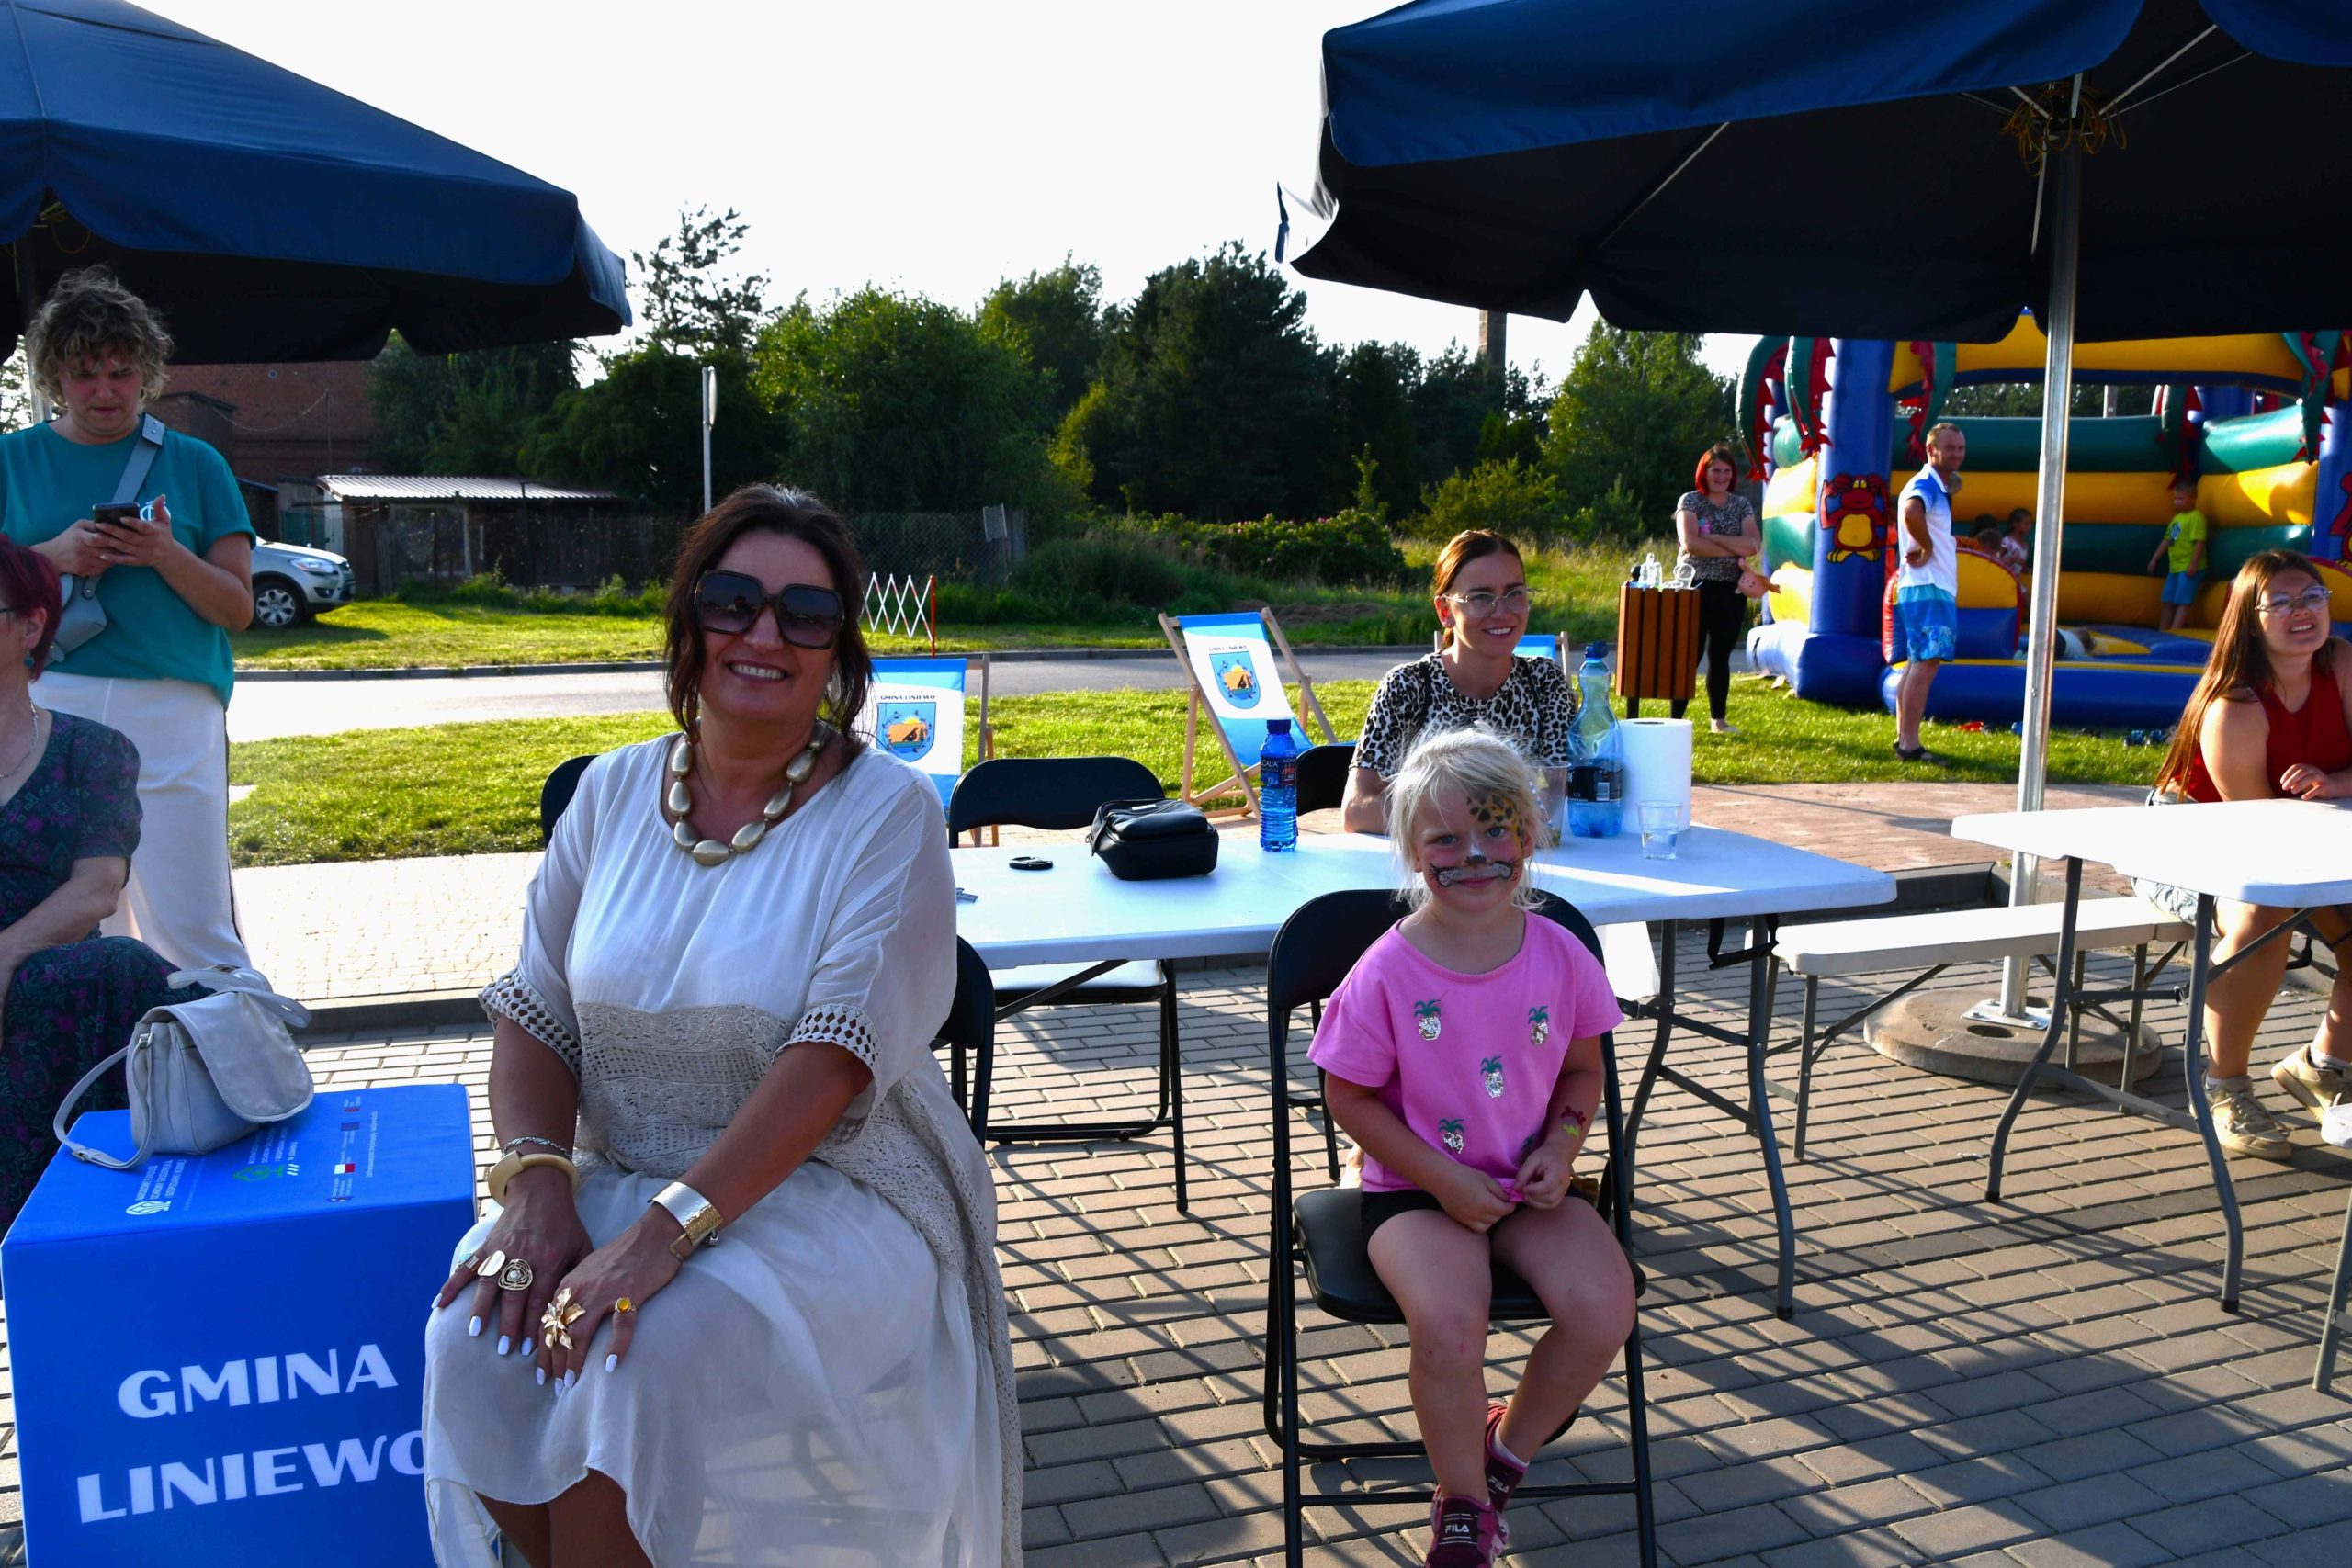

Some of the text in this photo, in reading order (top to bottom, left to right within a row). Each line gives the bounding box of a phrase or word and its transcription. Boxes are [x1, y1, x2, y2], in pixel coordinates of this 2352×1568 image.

[117, 1343, 399, 1419] GMINA
[1488, 1477, 1510, 1493] FILA
[1445, 1523, 1470, 1533] FILA
